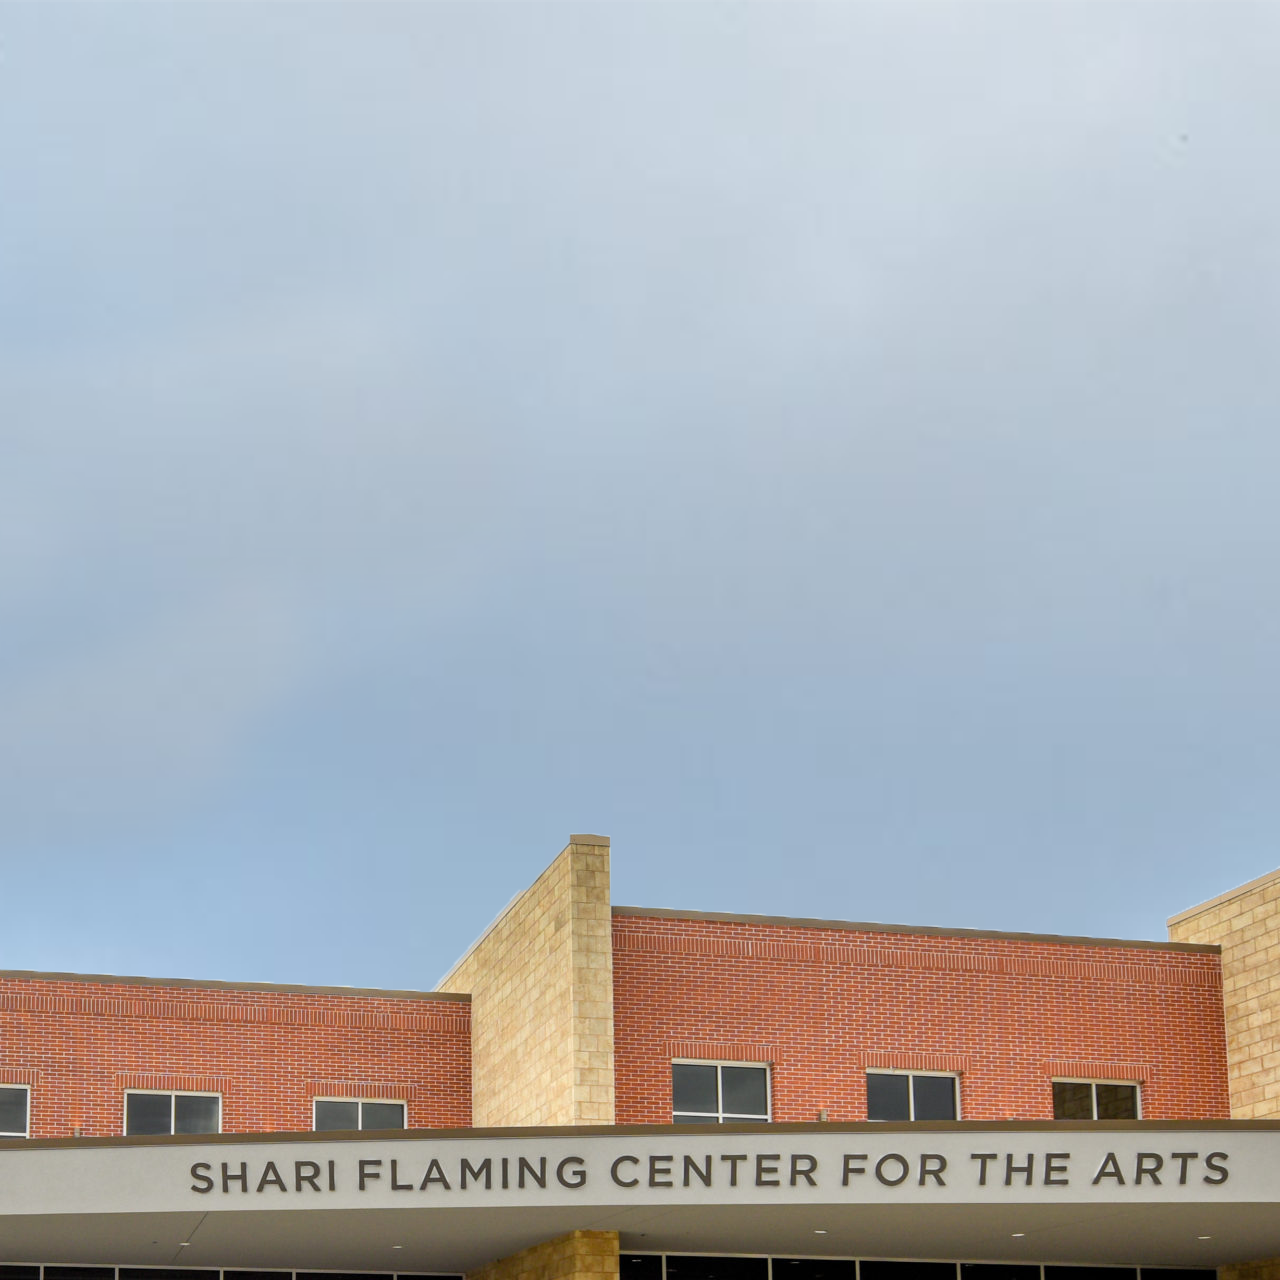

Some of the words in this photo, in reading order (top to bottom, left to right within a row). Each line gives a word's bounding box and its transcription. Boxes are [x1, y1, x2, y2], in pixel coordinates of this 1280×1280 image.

[190, 1160, 336, 1194] SHARI
[358, 1156, 588, 1192] FLAMING
[610, 1153, 818, 1189] CENTER
[841, 1152, 948, 1187] FOR
[970, 1152, 1072, 1187] THE
[1092, 1151, 1231, 1186] ARTS
